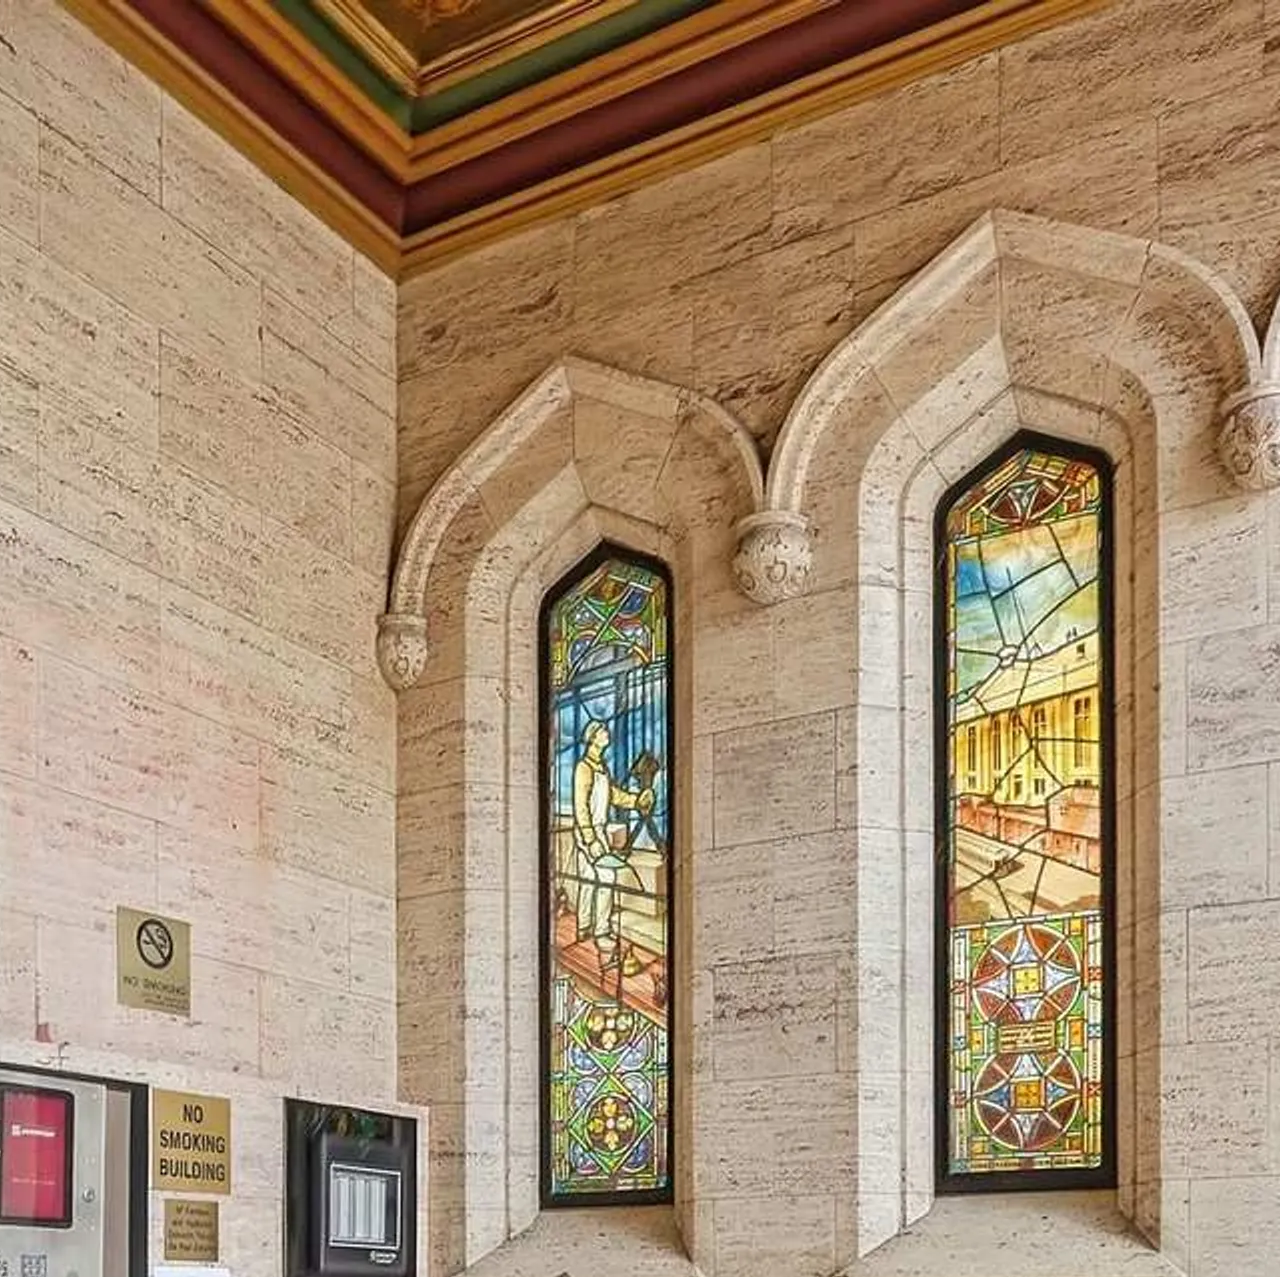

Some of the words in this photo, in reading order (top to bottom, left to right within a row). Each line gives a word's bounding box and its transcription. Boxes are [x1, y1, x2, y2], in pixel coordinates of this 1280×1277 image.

[183, 1103, 204, 1124] NO
[159, 1129, 226, 1154] SMOKING
[159, 1158, 226, 1182] BUILDING
